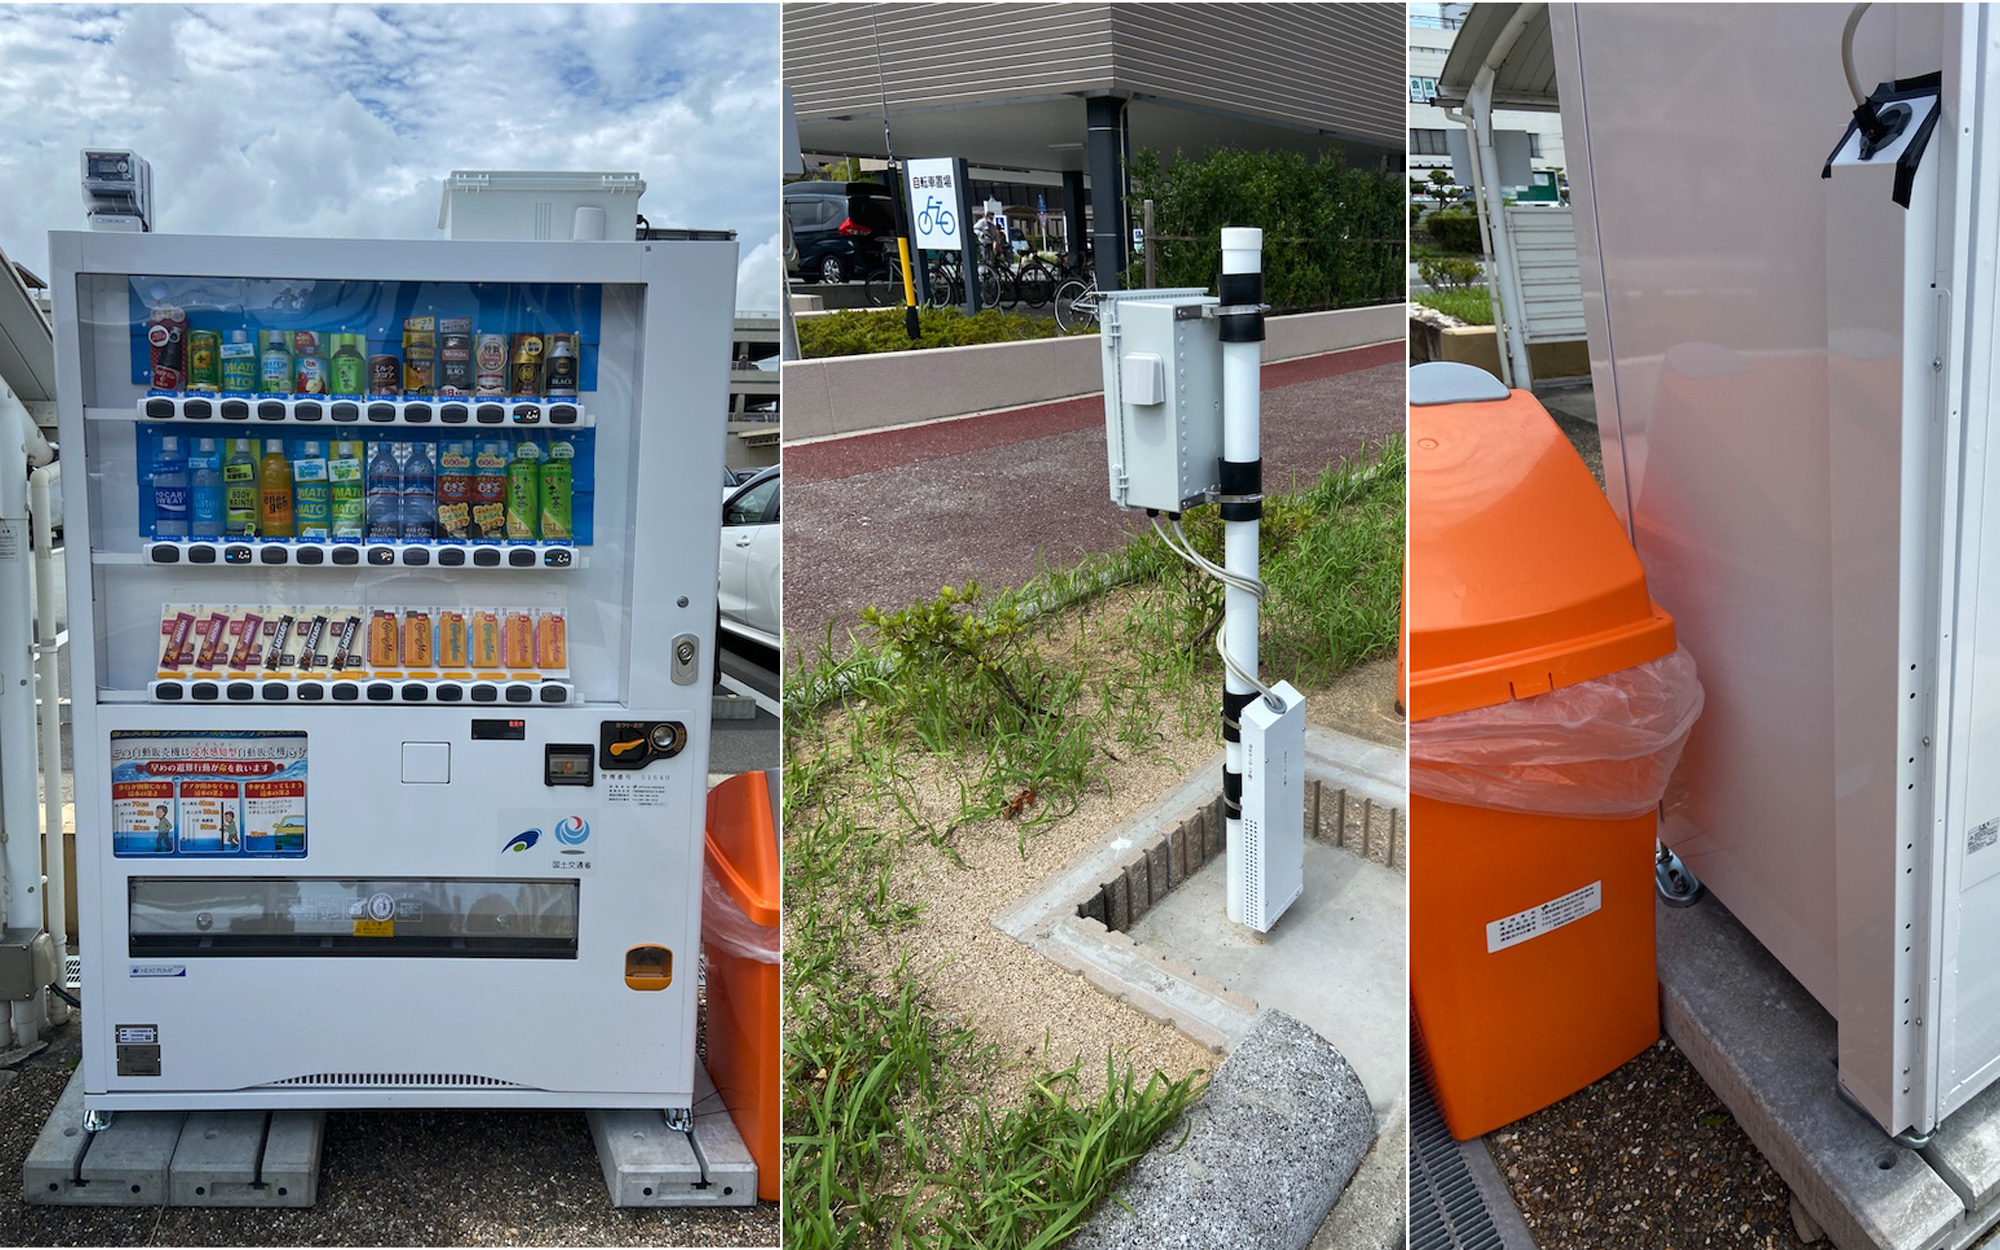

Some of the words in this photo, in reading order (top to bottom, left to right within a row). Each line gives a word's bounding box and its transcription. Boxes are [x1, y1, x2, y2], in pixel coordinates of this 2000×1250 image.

[913, 175, 952, 189] 自転車置場
[232, 491, 251, 499] BODY
[150, 762, 270, 773] 早めの避難行動が命を救います
[552, 860, 592, 870] 国土交通省
